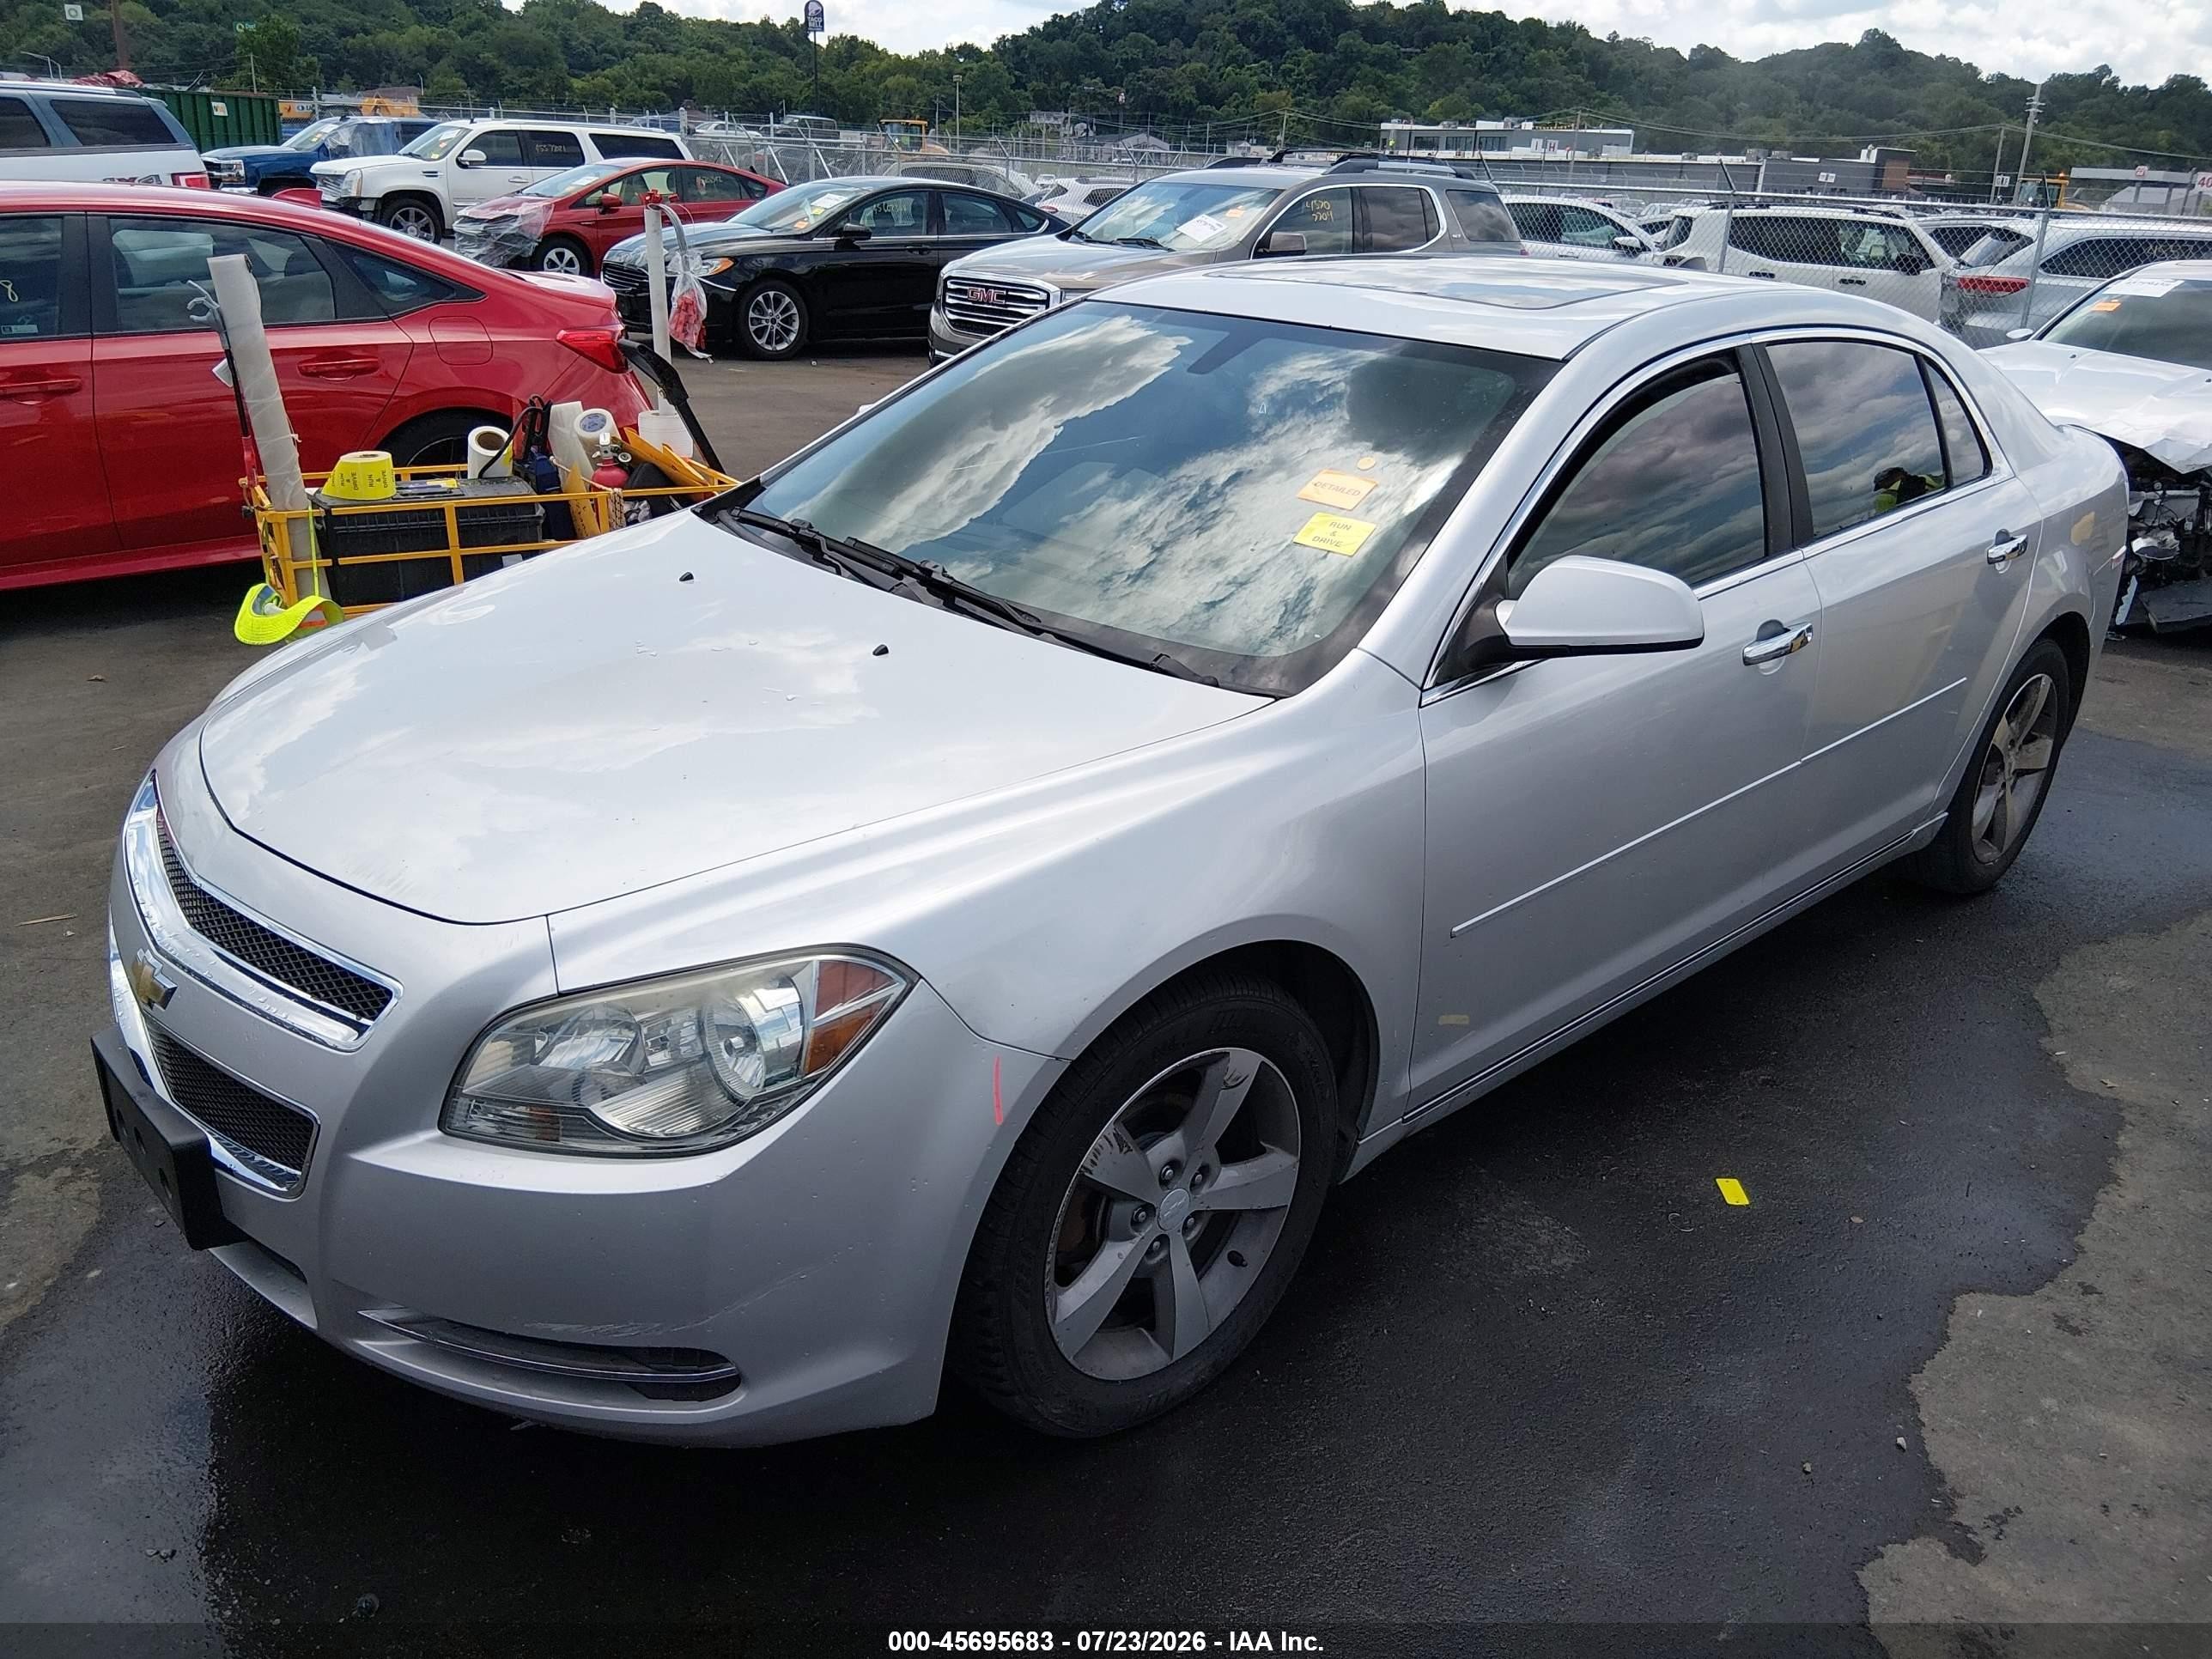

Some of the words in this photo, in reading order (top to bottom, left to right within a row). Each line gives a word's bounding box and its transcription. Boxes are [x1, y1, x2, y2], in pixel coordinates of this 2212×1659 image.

[967, 286, 1006, 305] GMC
[350, 471, 359, 491] DRIVE
[367, 474, 375, 488] RUN
[1313, 481, 1361, 496] DETAILED
[1328, 521, 1352, 531] RUN
[1312, 536, 1344, 548] DRIVE
